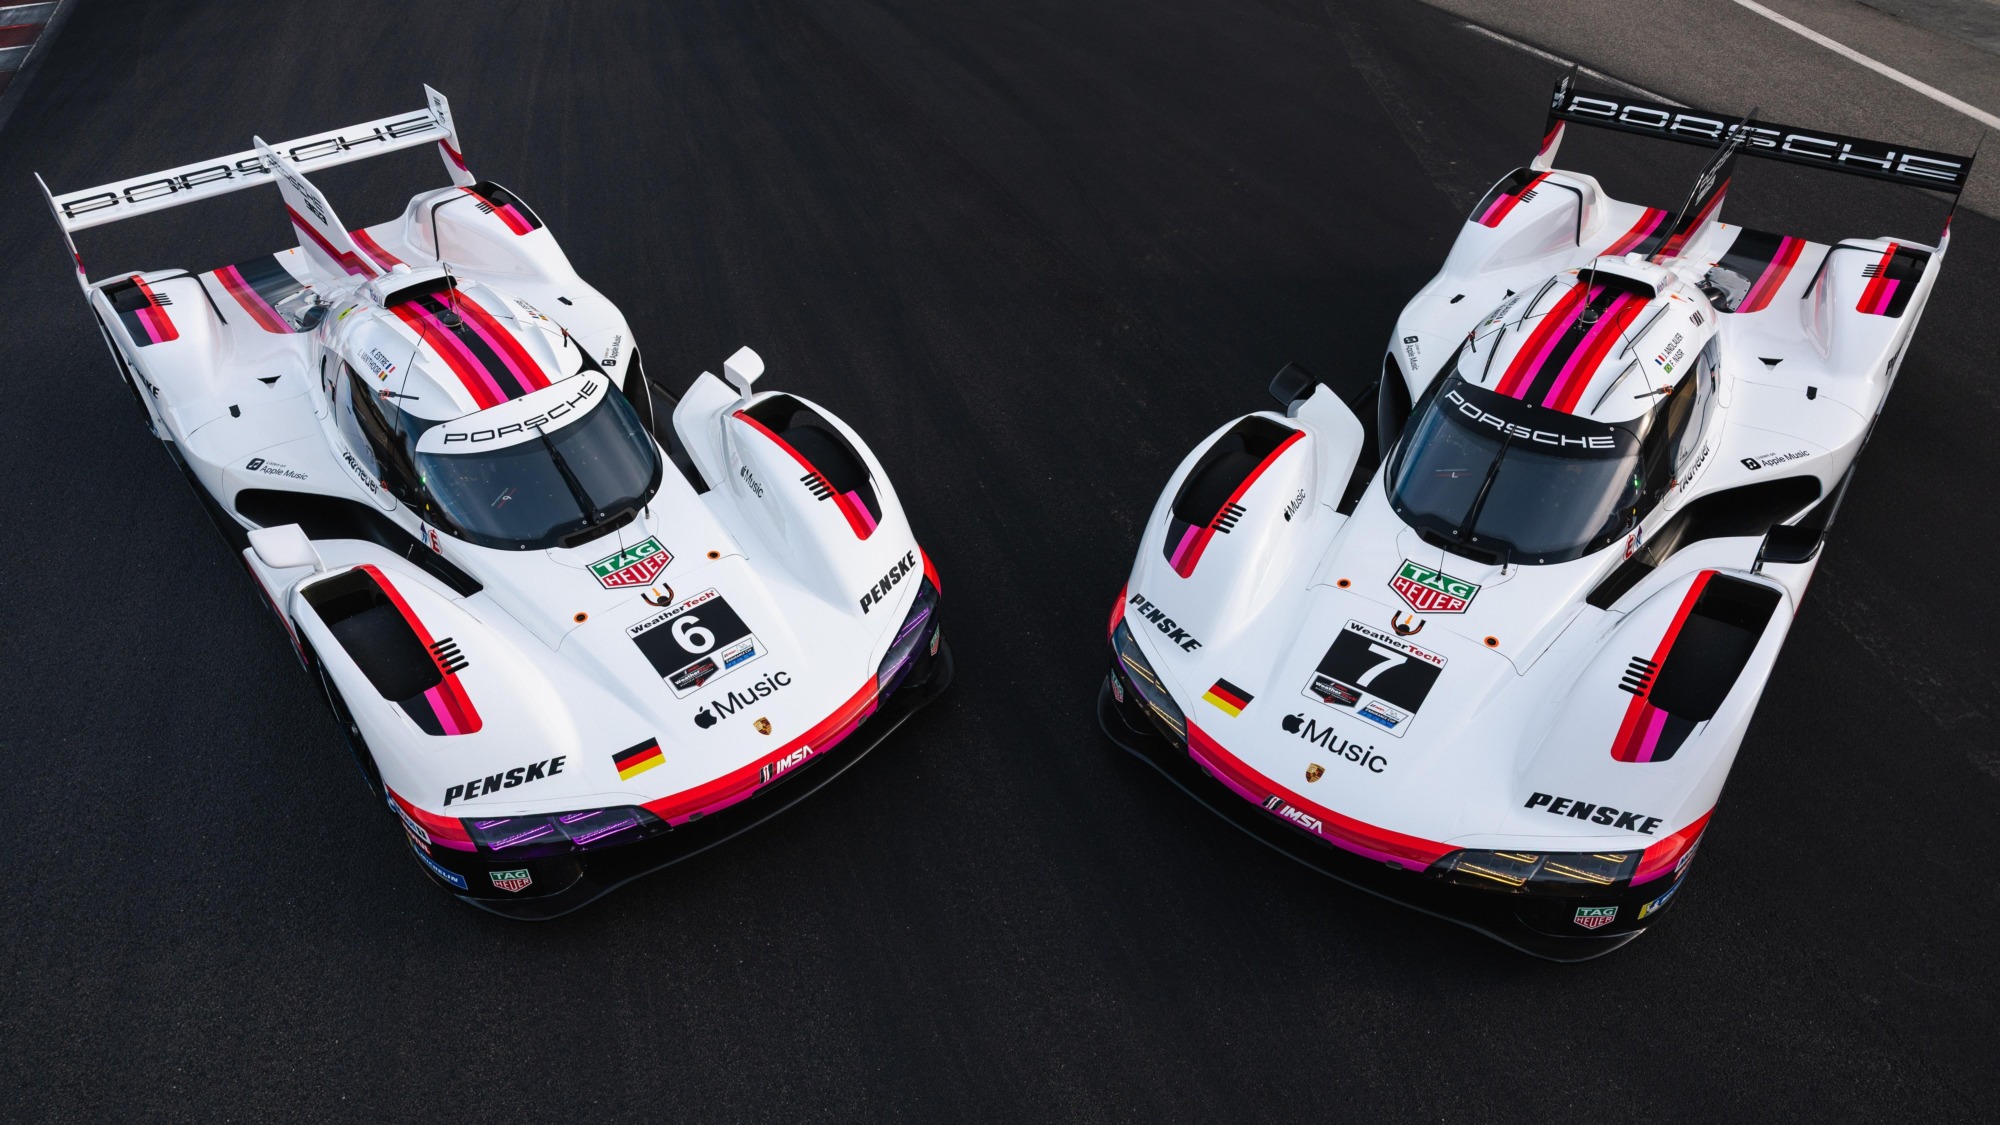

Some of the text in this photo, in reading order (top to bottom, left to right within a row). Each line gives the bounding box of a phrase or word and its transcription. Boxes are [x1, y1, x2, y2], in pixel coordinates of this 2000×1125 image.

[1567, 95, 1962, 181] PORSCHE
[360, 352, 382, 375] VANTHOOR
[374, 351, 390, 367] ESTRE
[443, 380, 598, 445] PORSCHE
[1445, 390, 1615, 449] PORSCHE
[260, 465, 308, 480] Apple Music
[1762, 450, 1810, 466] Apple Music
[744, 469, 764, 498] Music
[1287, 488, 1306, 517] Music
[596, 543, 657, 572] TAG
[605, 553, 667, 585] HEUER
[859, 550, 916, 615] PENSKE
[1396, 578, 1463, 609] HEUER
[1410, 565, 1469, 597] TAG
[631, 590, 715, 634] WeatherTech
[1129, 593, 1203, 653] PENSKE
[671, 615, 716, 654] 6
[1350, 622, 1441, 665] WeatherTech
[1356, 642, 1409, 688] 7
[712, 670, 792, 720] Music
[776, 745, 814, 774] IMSA
[1301, 719, 1388, 774] Music
[443, 755, 567, 807] PENSKE
[1280, 805, 1324, 834] IMSA
[1523, 791, 1663, 835] PENSKE
[493, 870, 528, 880] TAG
[493, 879, 531, 892] HEUER
[1576, 916, 1614, 928] HEUER
[1580, 908, 1615, 917] TAG
